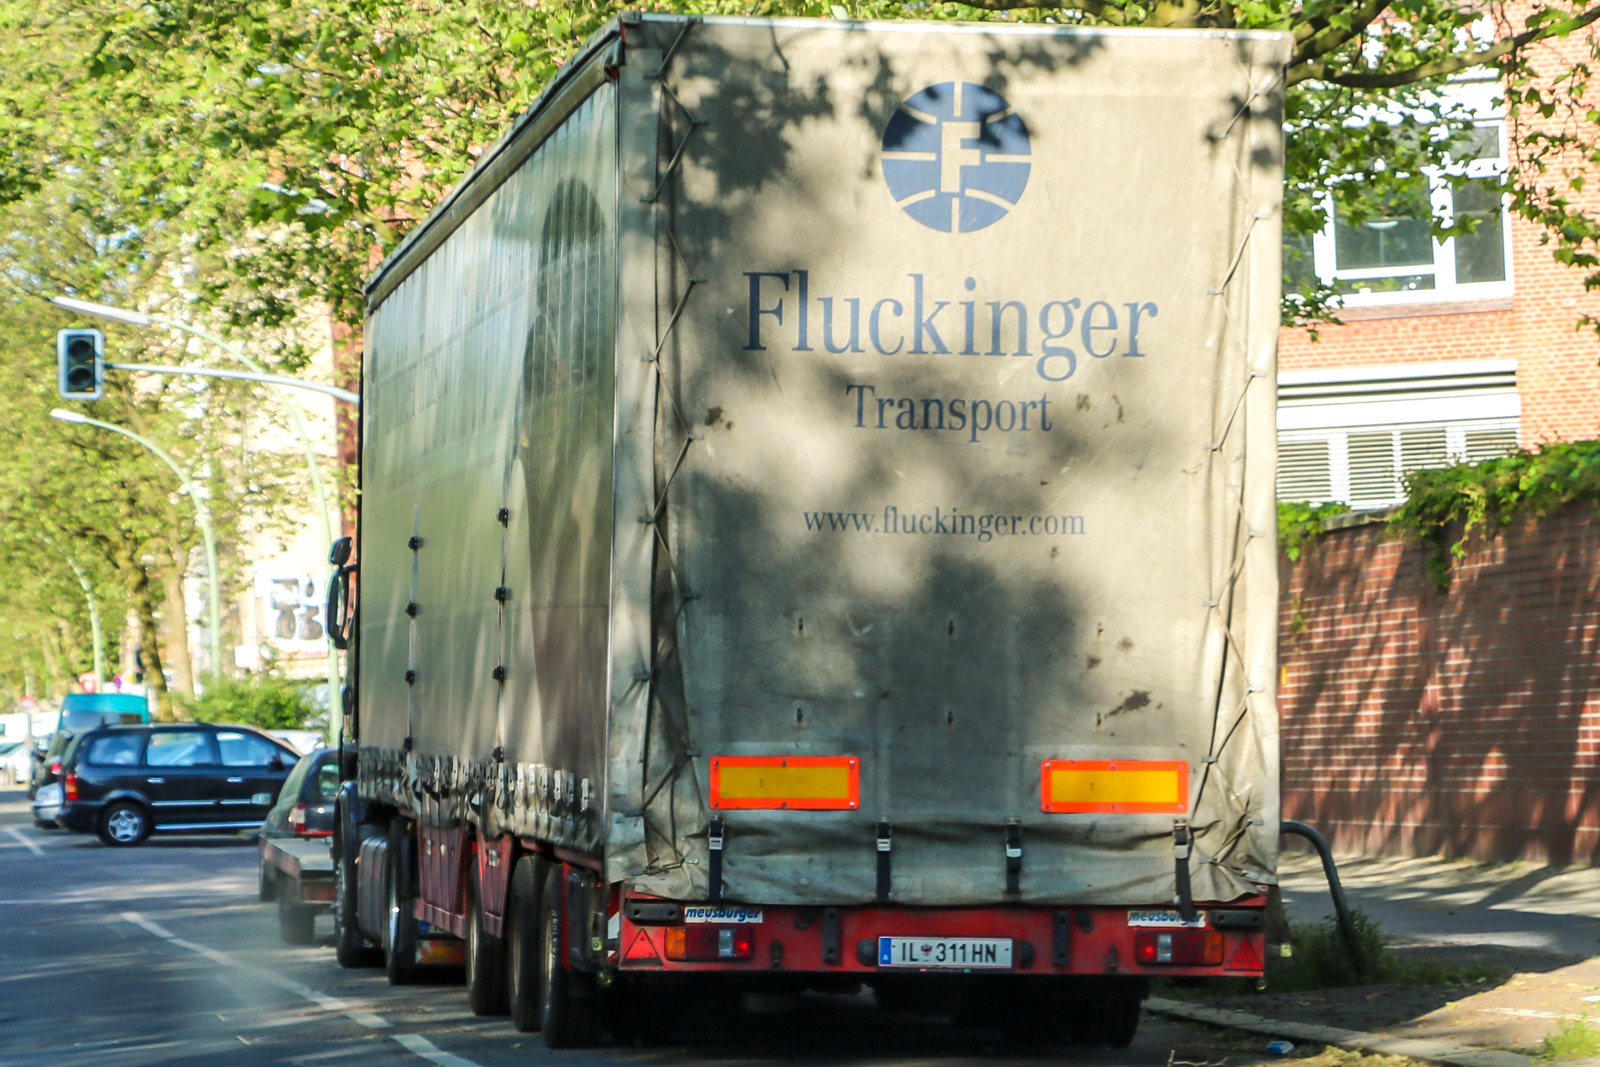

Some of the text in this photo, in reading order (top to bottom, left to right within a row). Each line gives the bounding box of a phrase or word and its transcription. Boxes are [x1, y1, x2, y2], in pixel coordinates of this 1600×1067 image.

[940, 121, 981, 193] F
[742, 269, 1158, 382] Fluckinger
[845, 384, 1053, 442] Transport
[803, 505, 1086, 542] www.fluckinger.com
[685, 907, 760, 921] meusburger
[902, 942, 997, 963] IL 311HN
